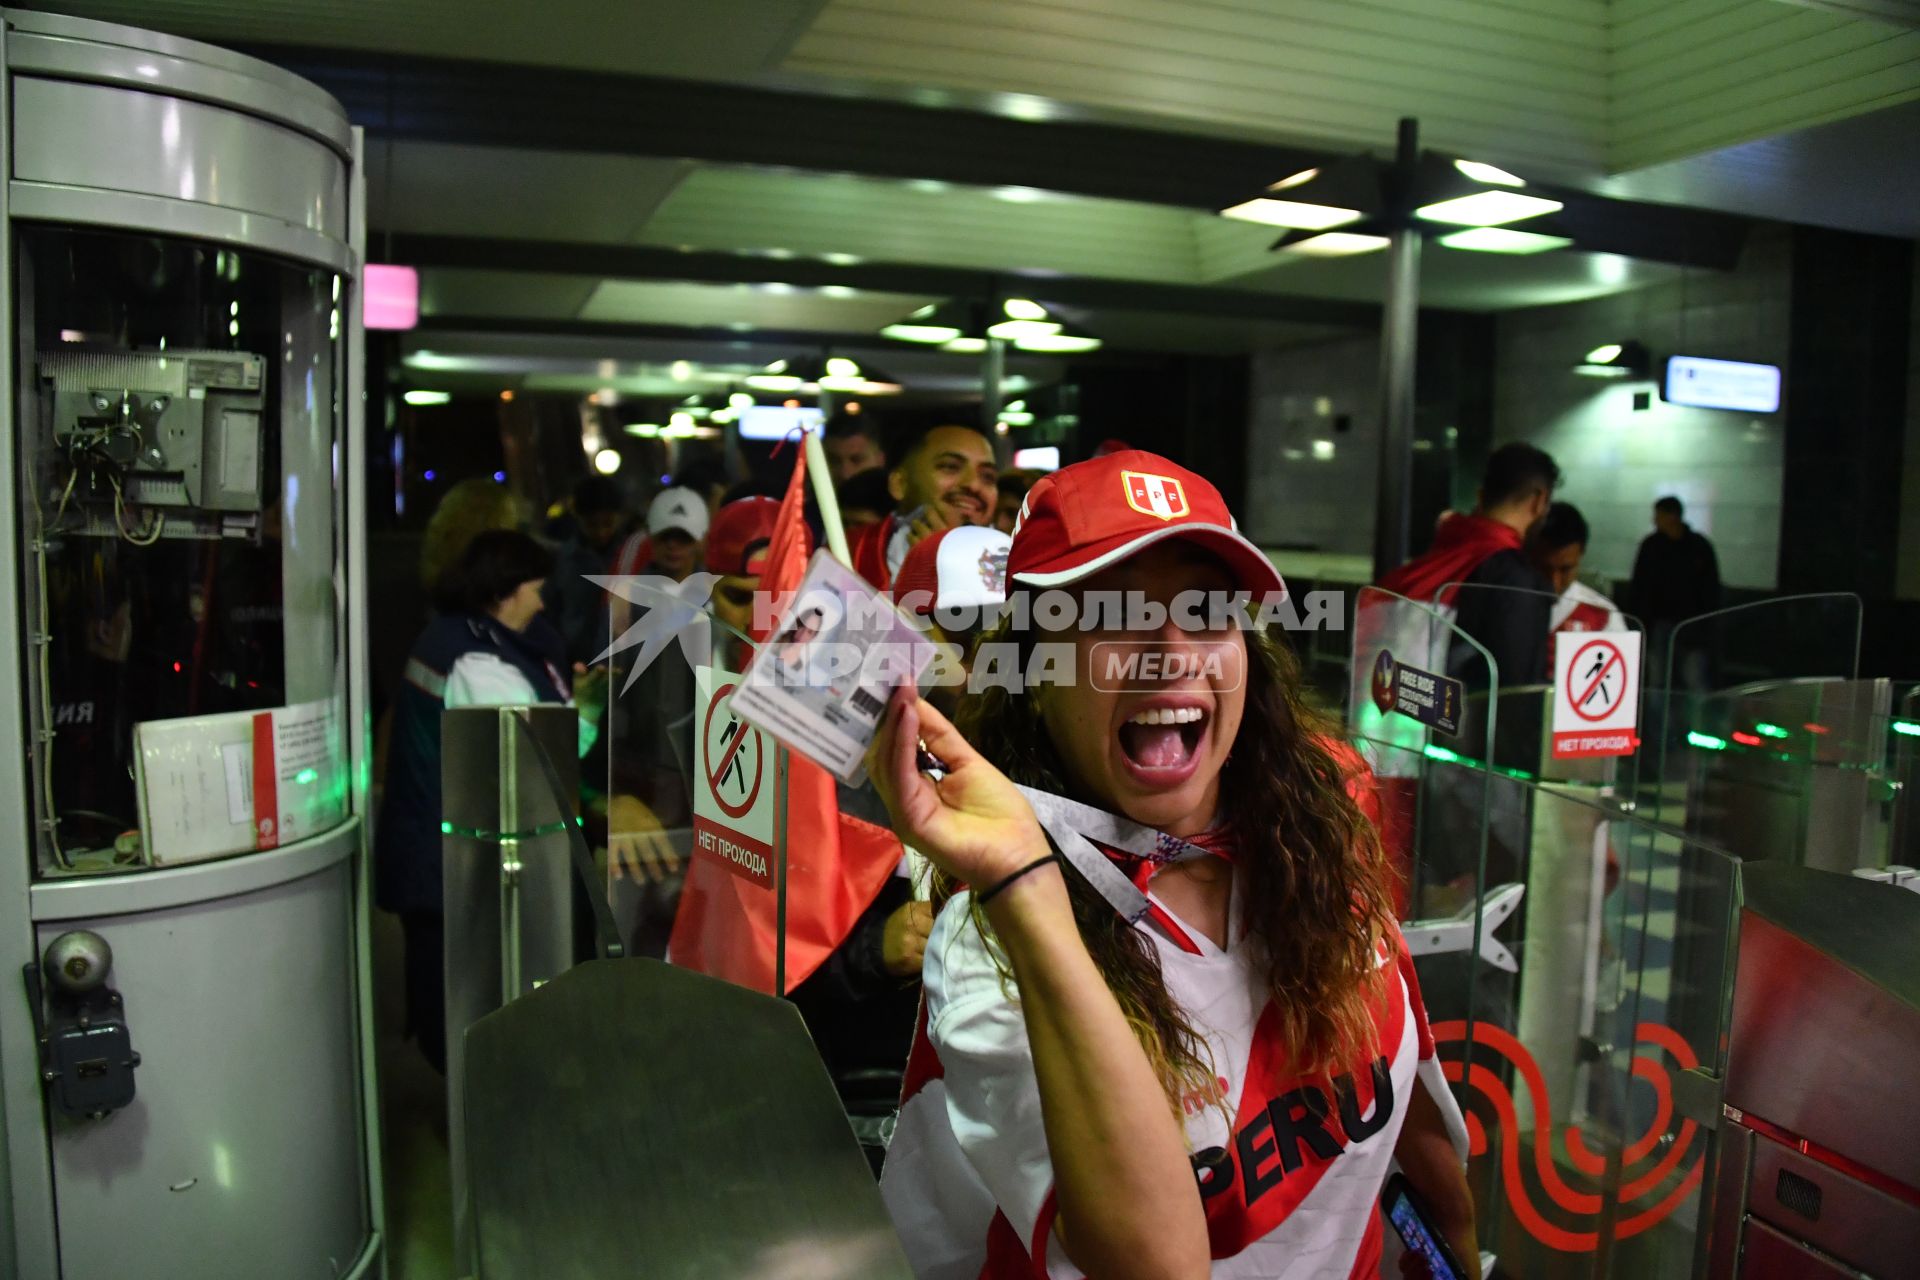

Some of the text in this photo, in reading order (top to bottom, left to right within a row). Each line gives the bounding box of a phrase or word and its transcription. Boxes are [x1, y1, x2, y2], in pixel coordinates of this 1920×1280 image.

[1400, 669, 1436, 695] FREE RIDE
[1557, 735, 1630, 752] НЕТ ПРОХОДА
[698, 829, 768, 877] НЕТ ПРОХОДА
[1189, 1055, 1395, 1208] PERU
